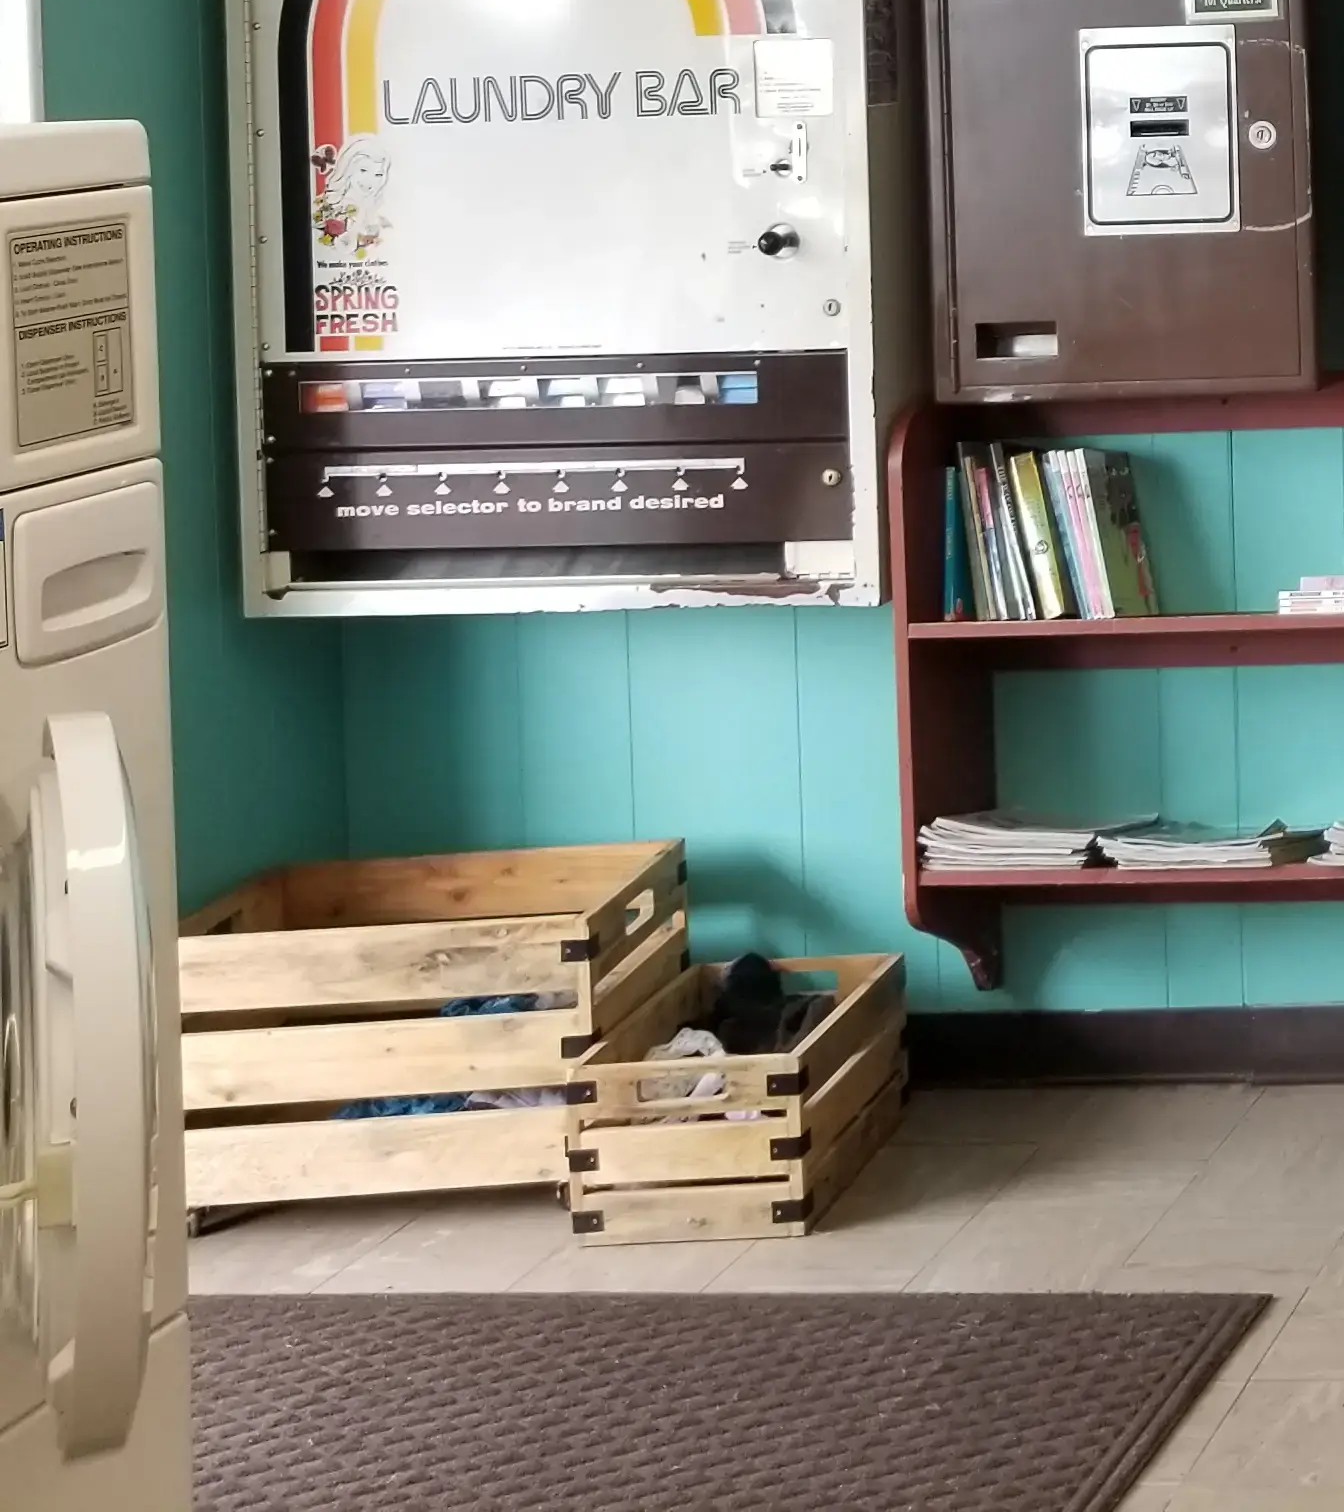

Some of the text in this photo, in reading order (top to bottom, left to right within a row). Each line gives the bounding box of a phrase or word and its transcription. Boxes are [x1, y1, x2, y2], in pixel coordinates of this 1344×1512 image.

[383, 71, 622, 125] LAUNDRY
[635, 68, 741, 117] BAR
[14, 229, 122, 255] OPERATING INSTRUCTIONS
[315, 285, 399, 311] SPRING
[19, 312, 126, 340] DISPENSER INSTRUCTIONS
[316, 312, 399, 334] FRESH
[336, 493, 724, 518] move selector to brand desired
